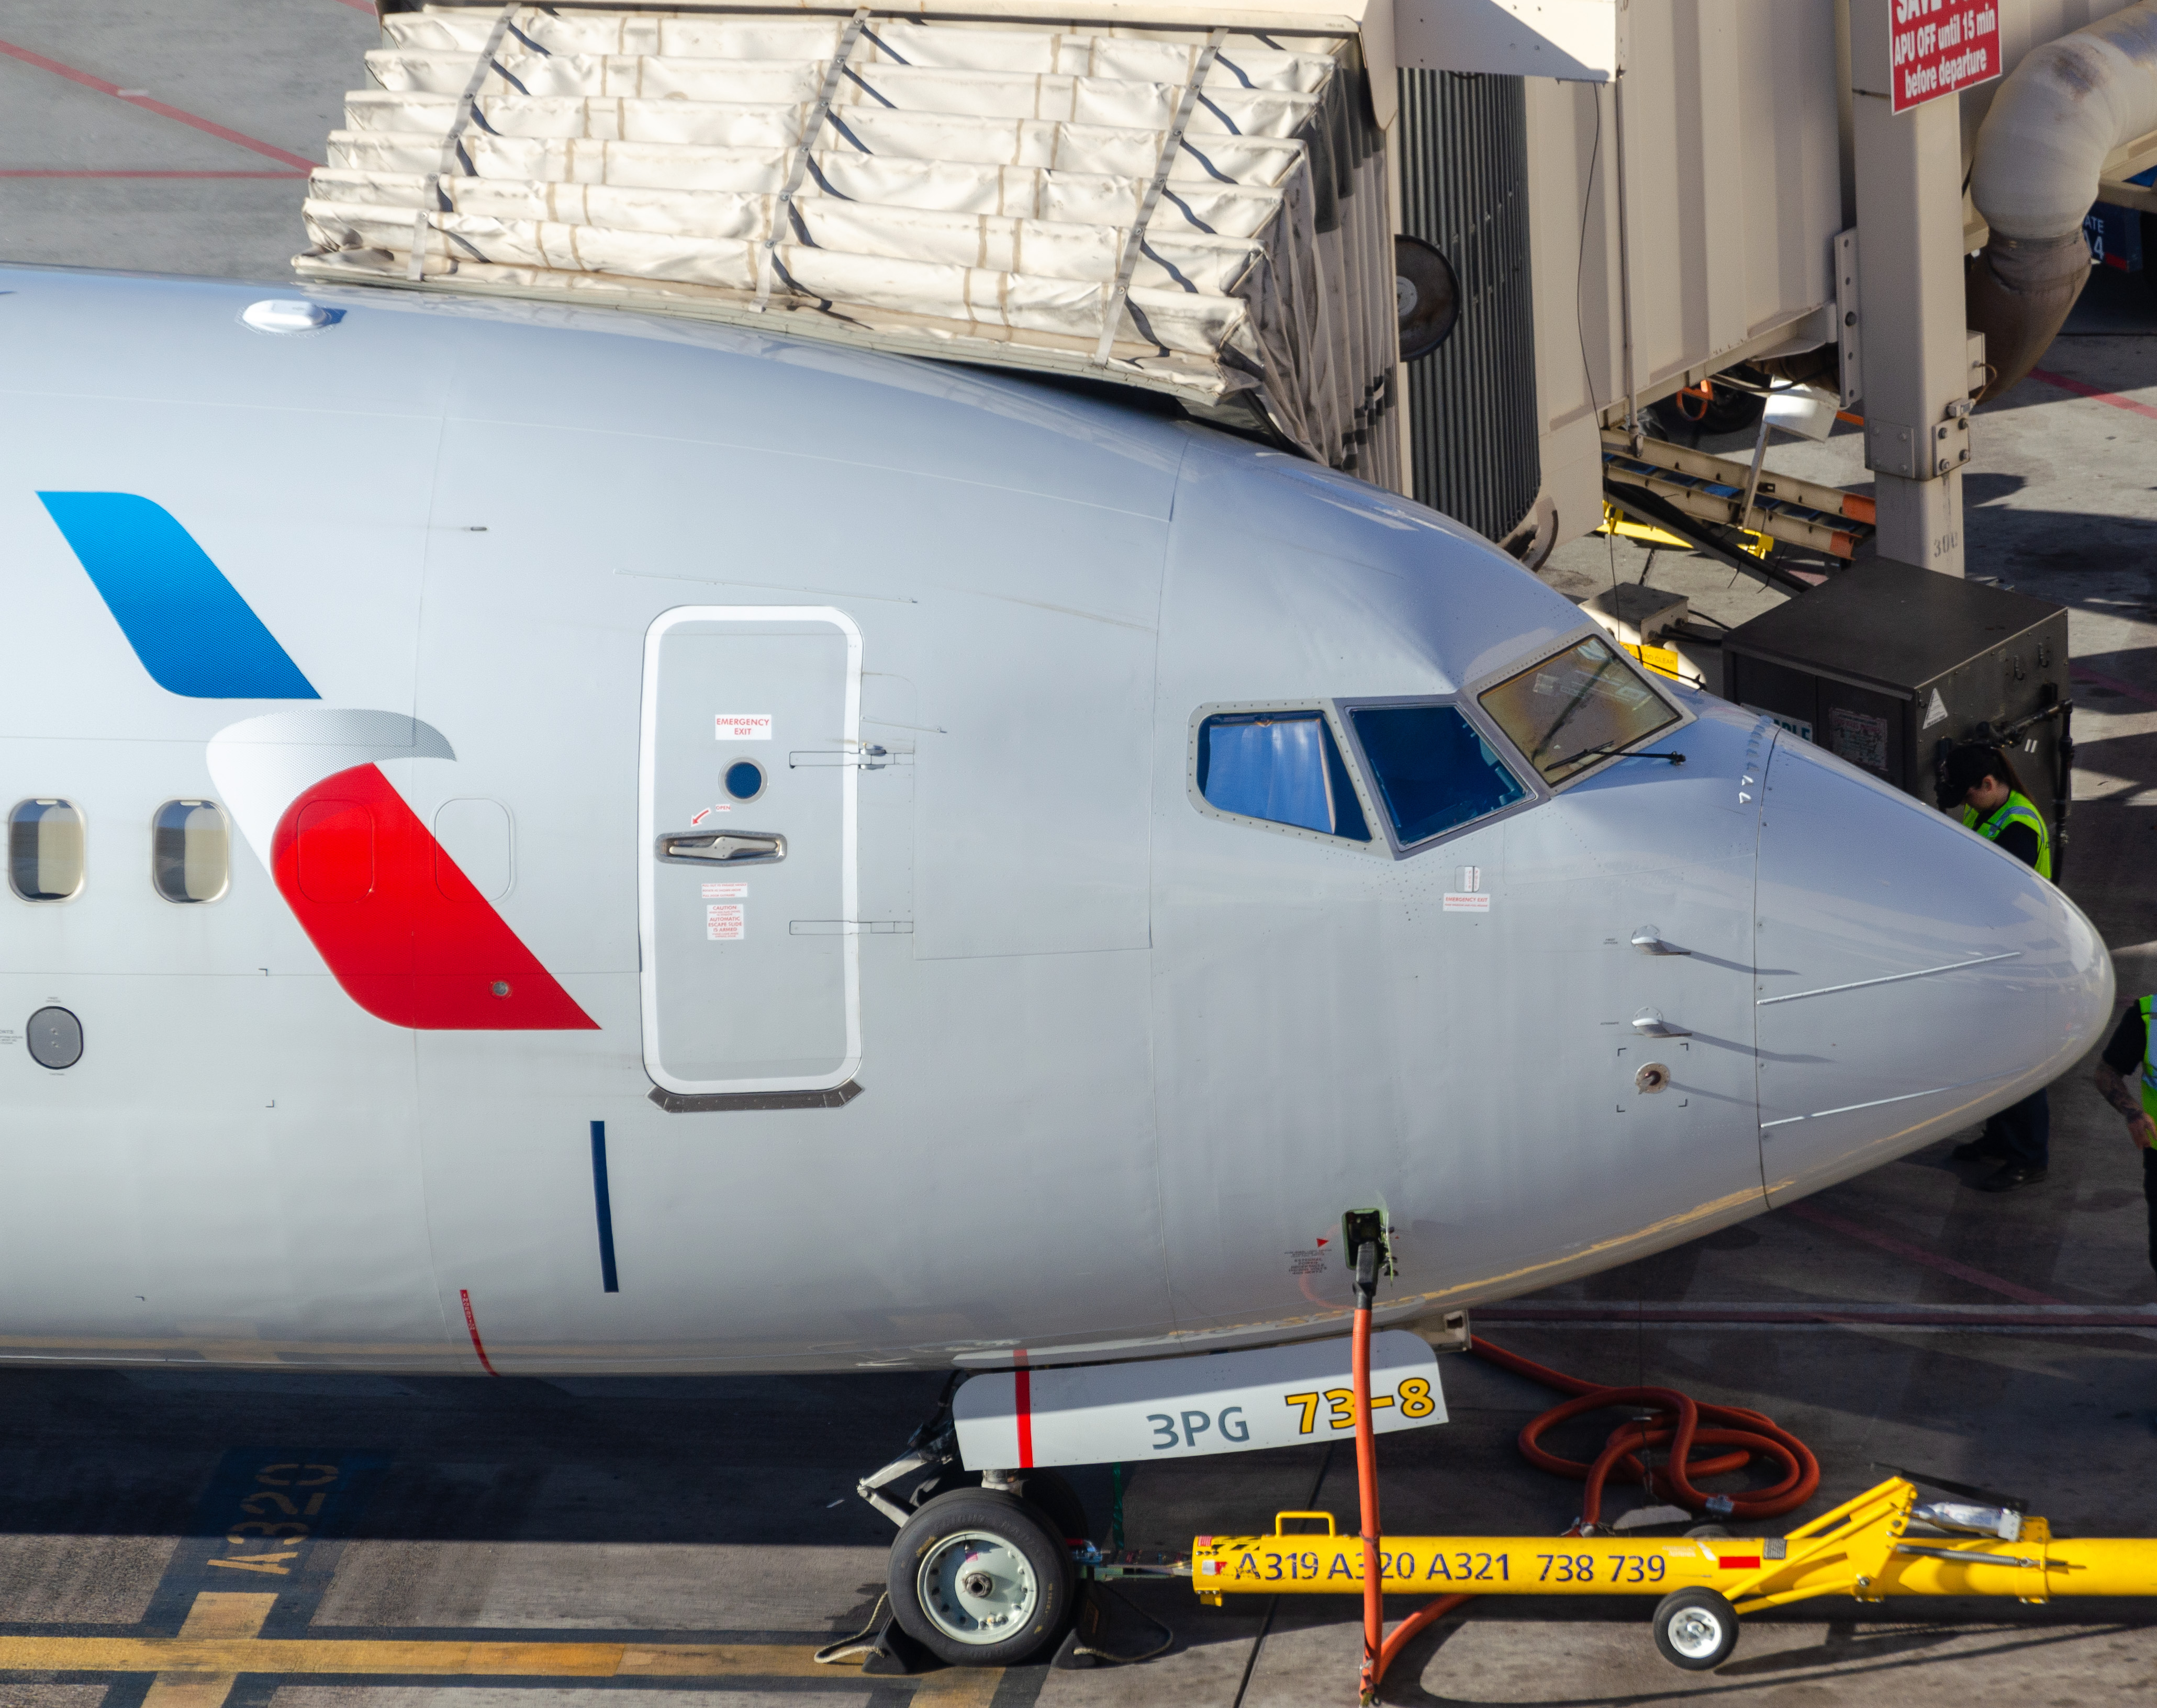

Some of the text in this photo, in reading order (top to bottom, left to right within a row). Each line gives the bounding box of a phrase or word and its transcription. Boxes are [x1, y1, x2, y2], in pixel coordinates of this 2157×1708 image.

[1894, 2, 1996, 66] APU OFF until 15 min
[1905, 47, 1987, 99] before departure
[2085, 215, 2104, 234] ATE
[1146, 1406, 1250, 1450] 3PG
[206, 1463, 339, 1575] A320
[1234, 1552, 1319, 1581] A319
[1426, 1553, 1509, 1580] A321
[1537, 1554, 1594, 1582] 738
[1607, 1554, 1666, 1582] 739
